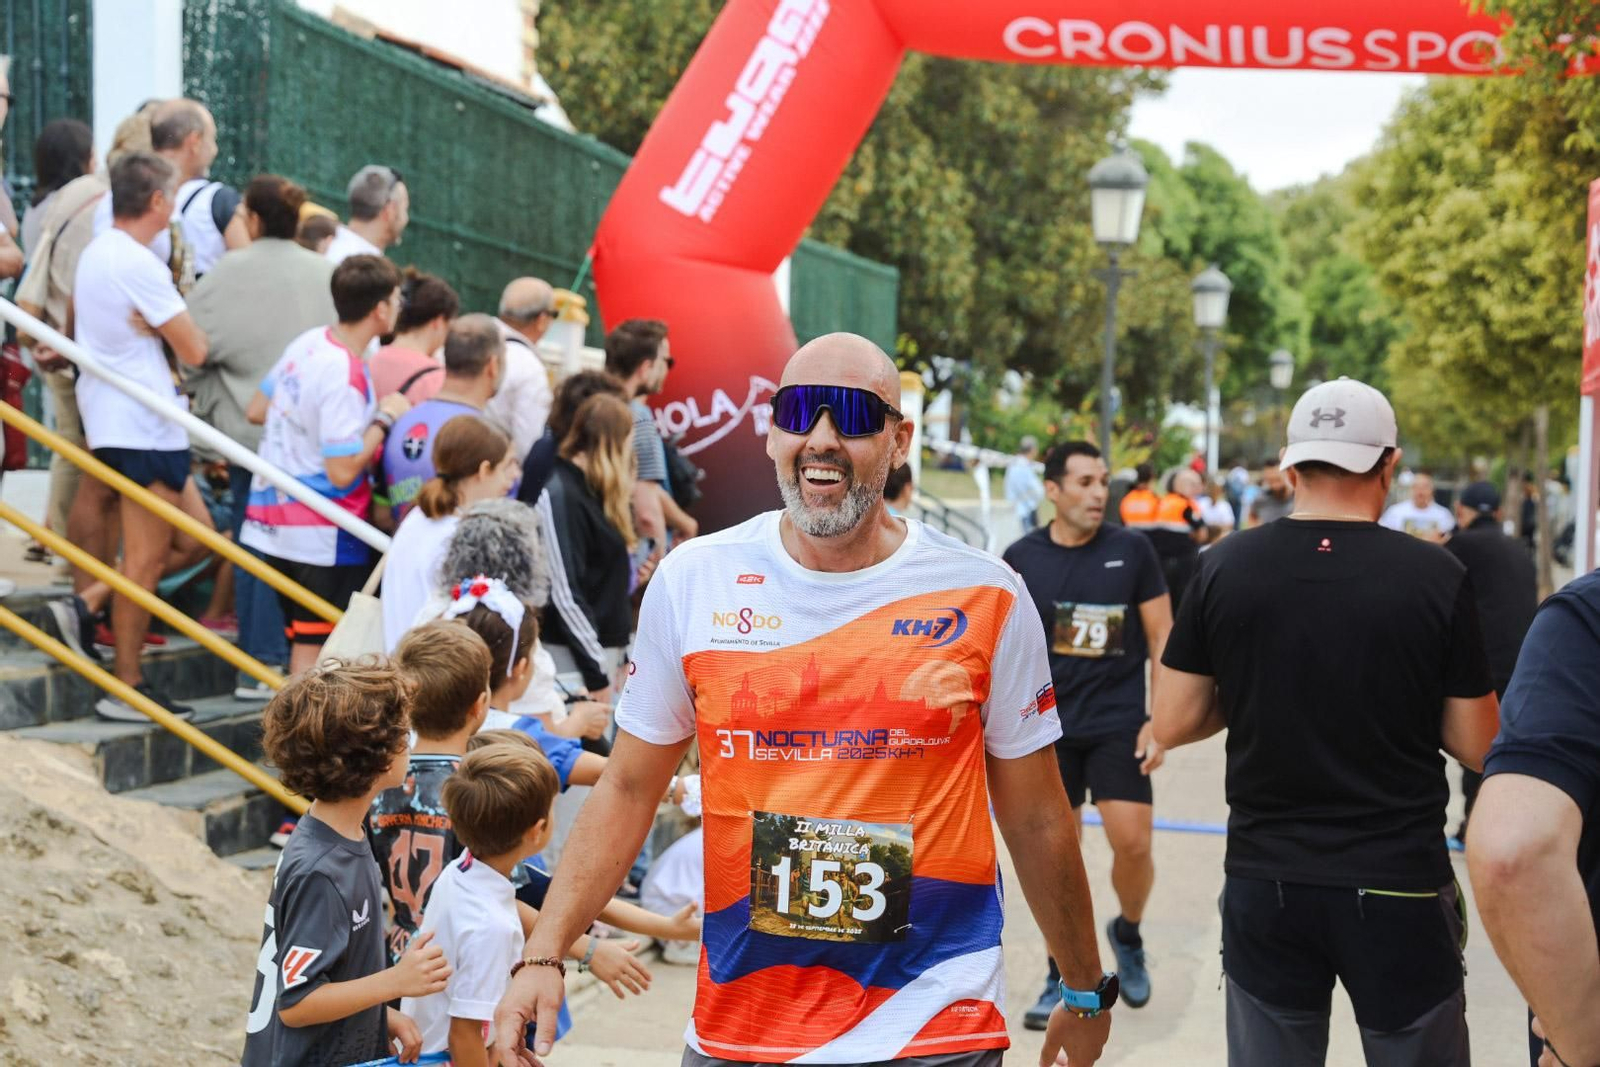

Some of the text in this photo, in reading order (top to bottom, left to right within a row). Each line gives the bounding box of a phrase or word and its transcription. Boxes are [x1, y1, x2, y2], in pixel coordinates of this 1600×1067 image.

[1072, 620, 1108, 649] 79
[716, 728, 910, 760] 37 NOCTURNA DEL
[755, 748, 833, 761] SEVILLA
[793, 820, 866, 838] II MILLA
[788, 836, 870, 855] BRITÁNICA
[771, 856, 887, 922] 153
